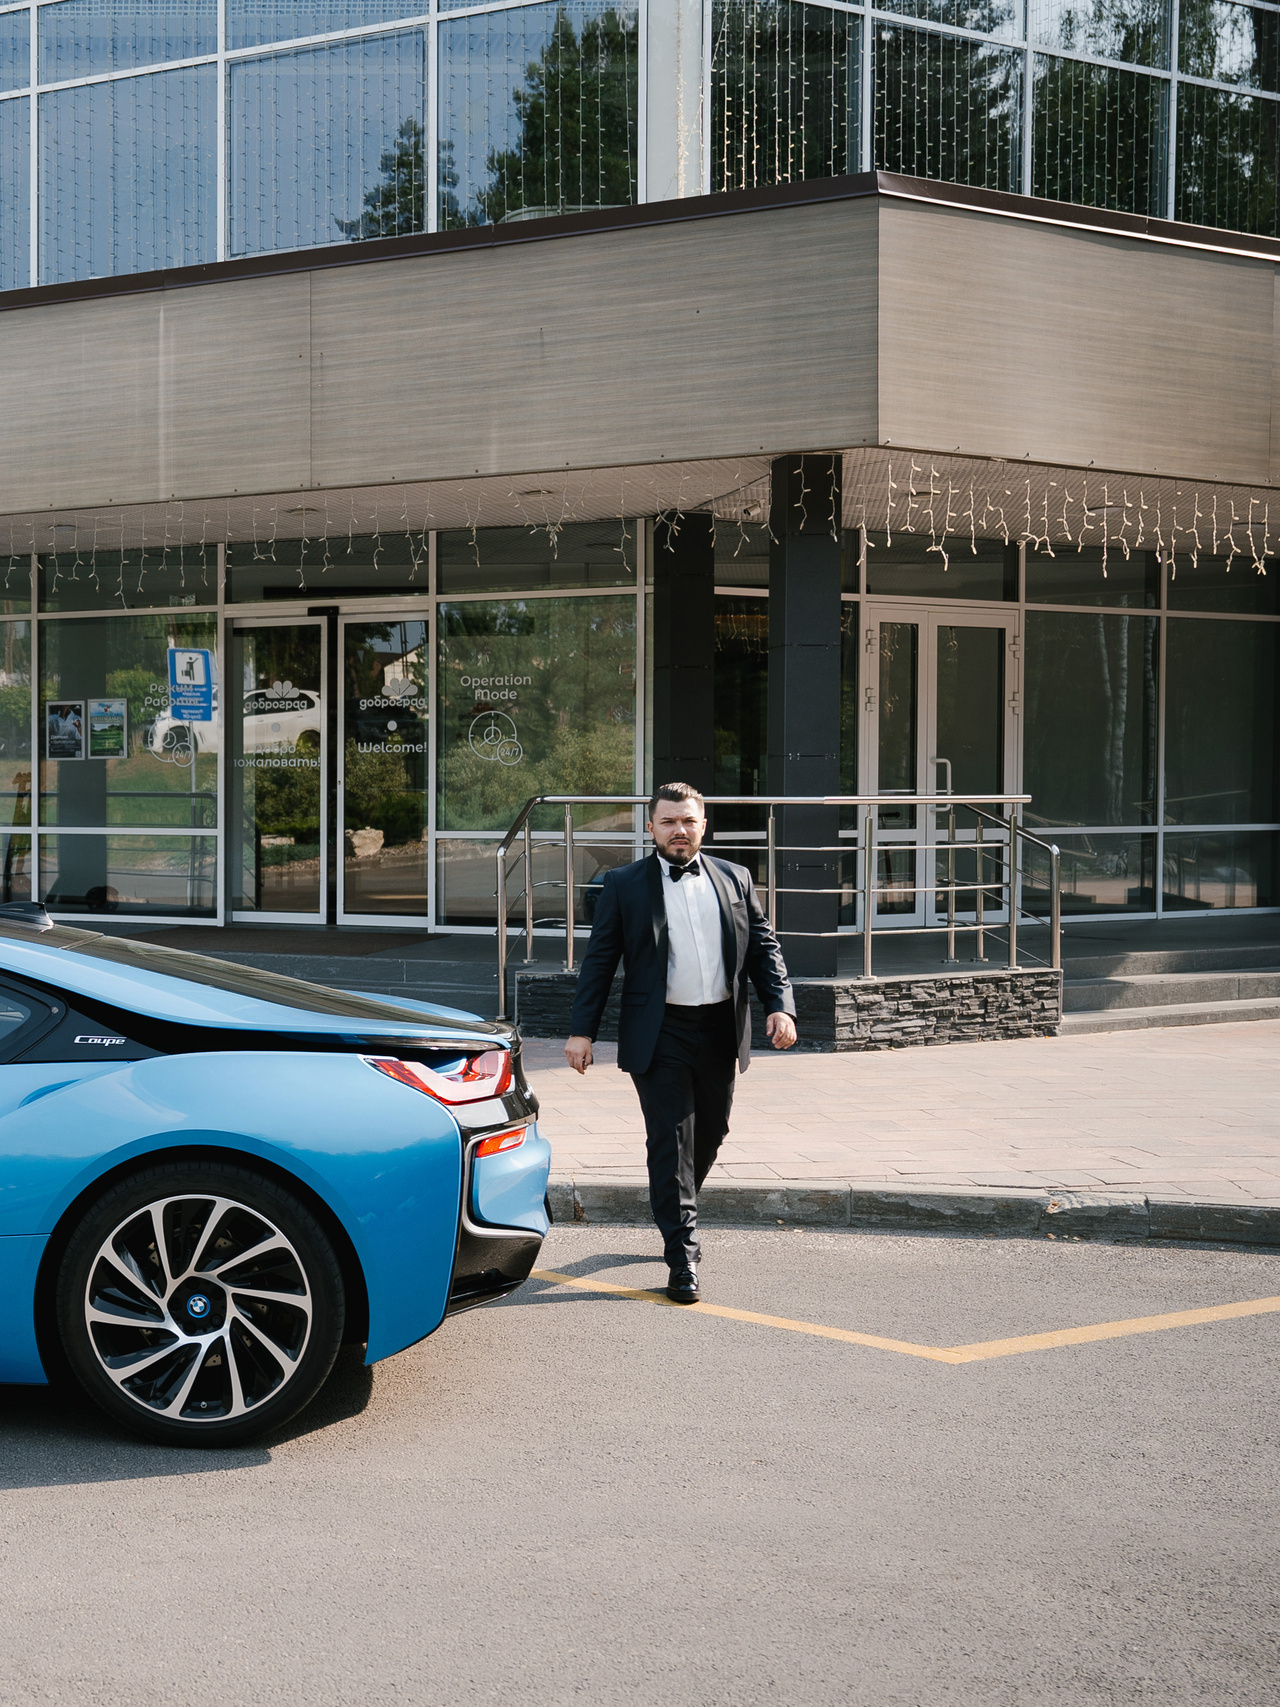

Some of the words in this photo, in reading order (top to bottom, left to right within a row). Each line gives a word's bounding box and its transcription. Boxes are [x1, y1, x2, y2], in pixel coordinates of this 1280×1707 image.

[460, 674, 532, 689] Operation
[474, 688, 517, 701] Mode
[252, 741, 296, 756] Добро
[357, 741, 428, 753] Welcome!
[500, 747, 519, 757] 24/7
[176, 751, 191, 759] 24/7
[73, 1035, 127, 1046] Coupe
